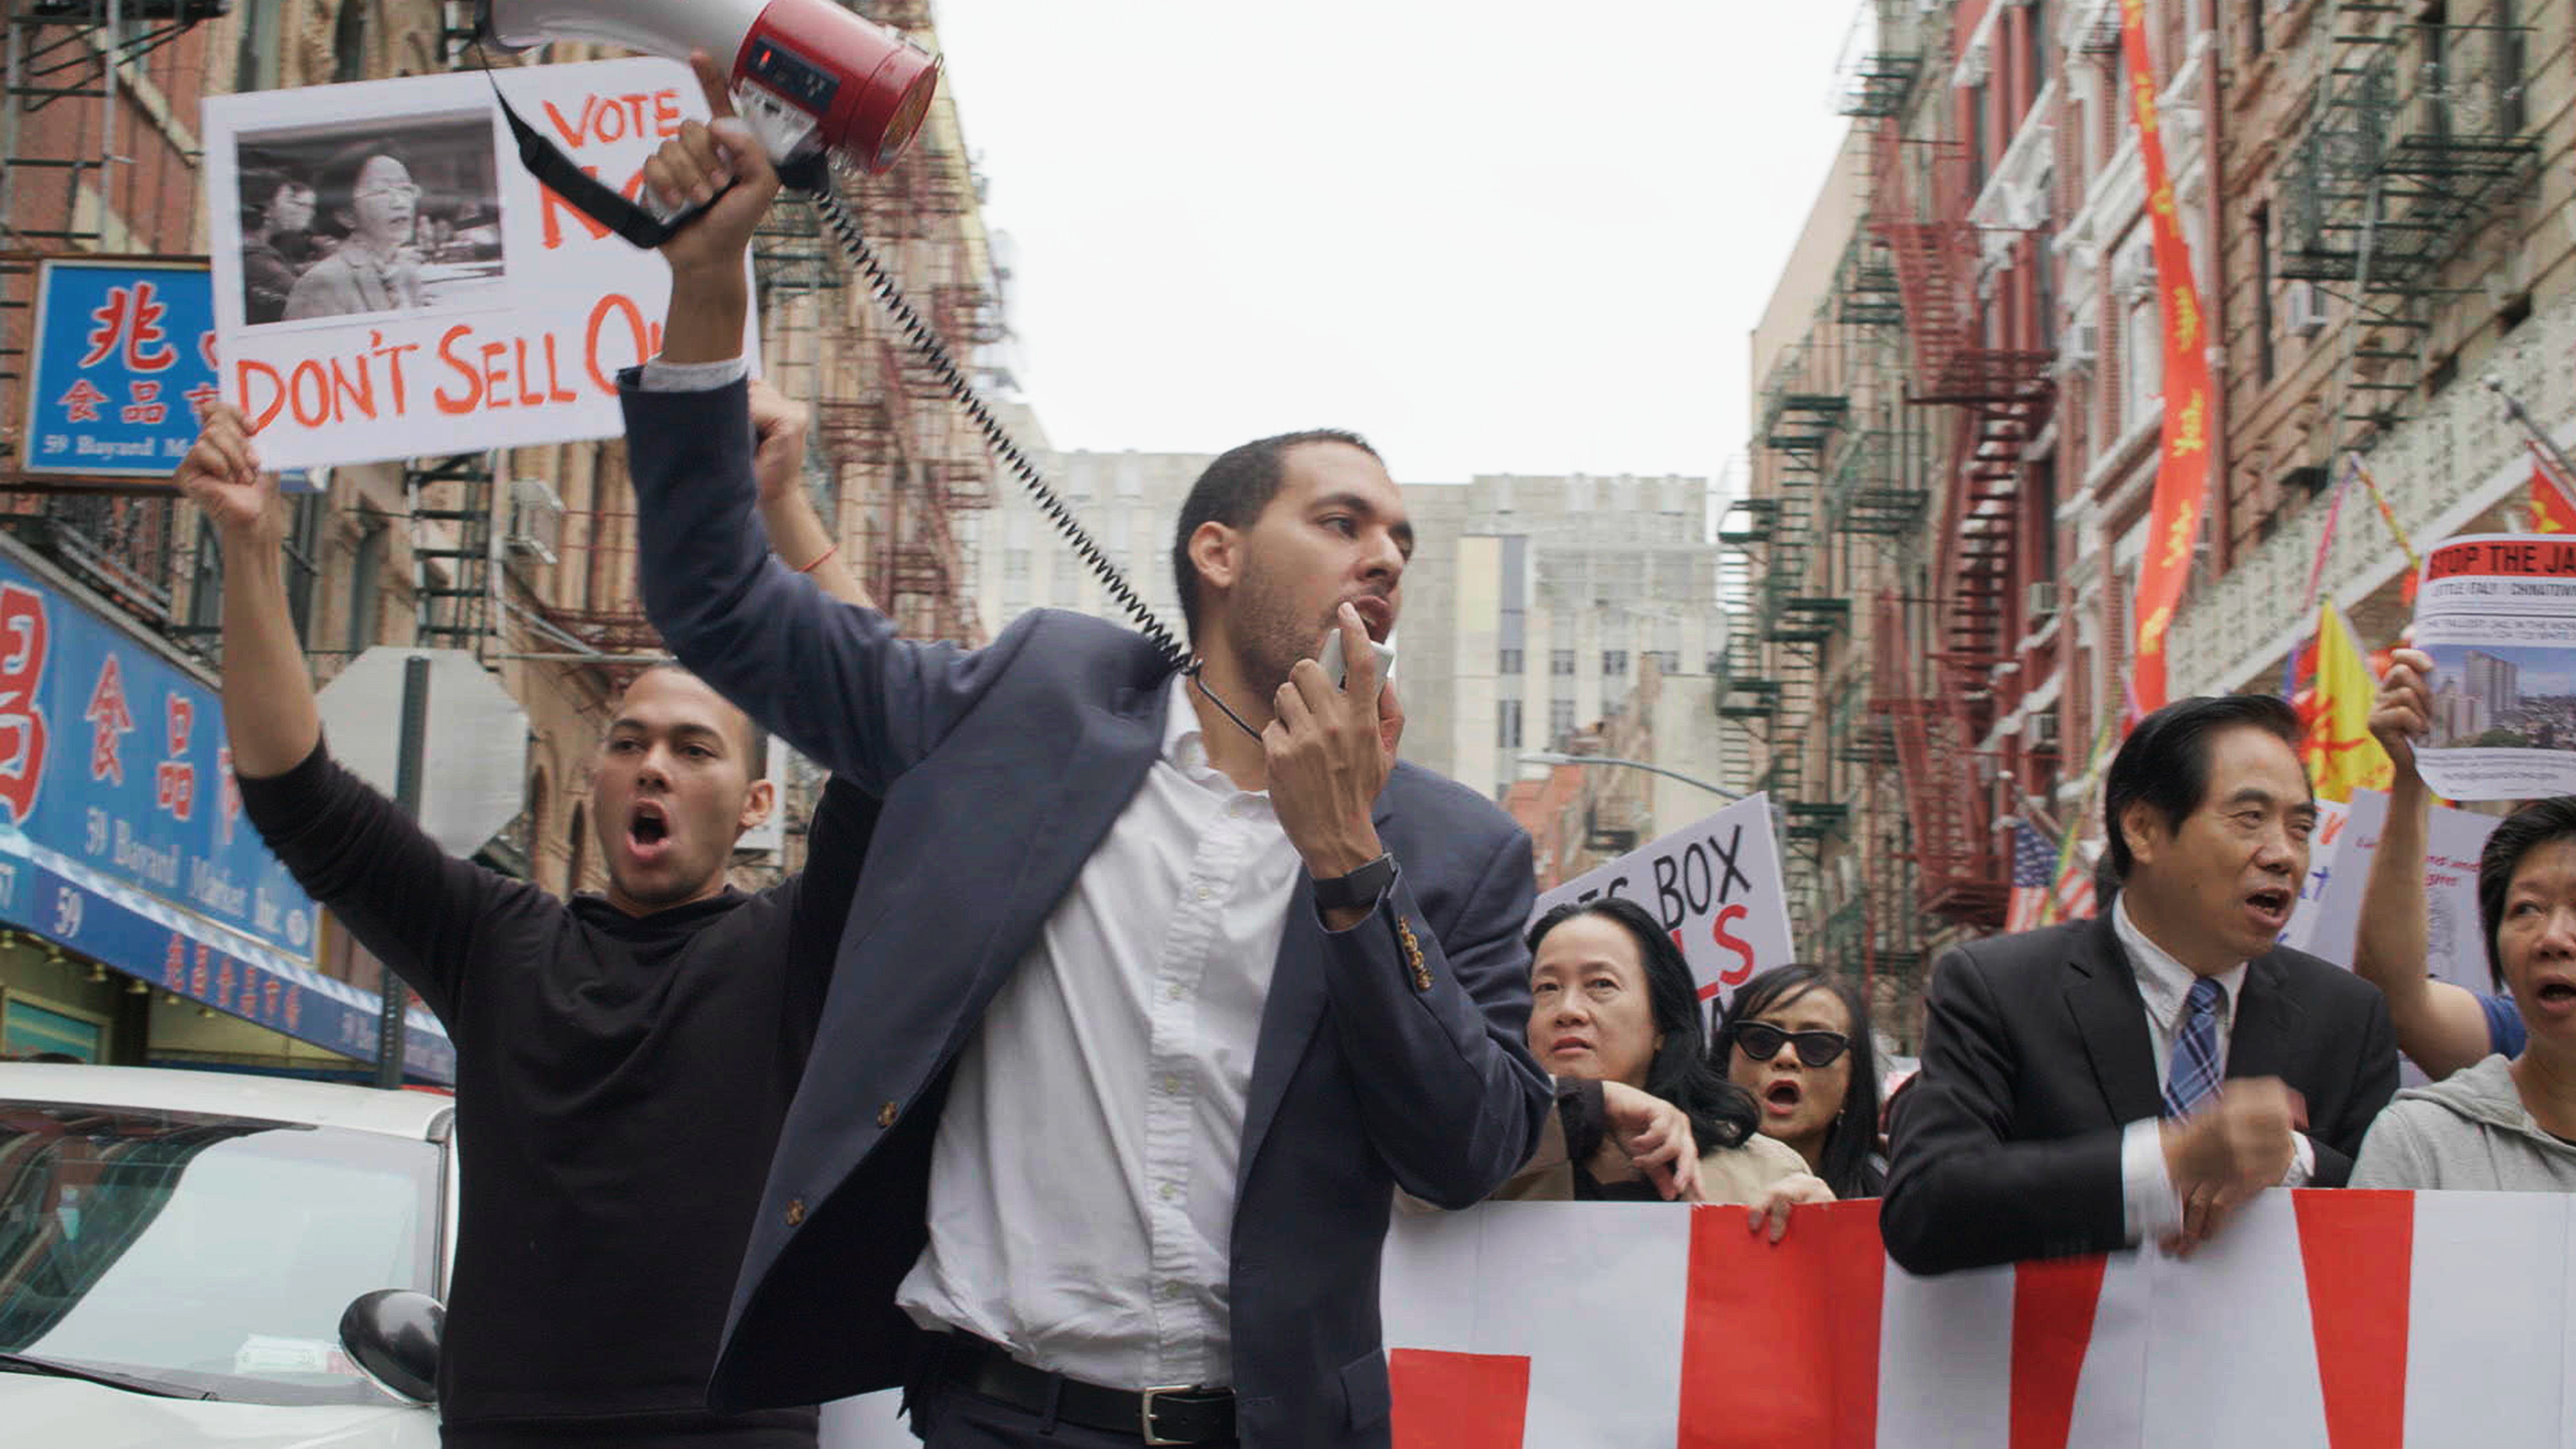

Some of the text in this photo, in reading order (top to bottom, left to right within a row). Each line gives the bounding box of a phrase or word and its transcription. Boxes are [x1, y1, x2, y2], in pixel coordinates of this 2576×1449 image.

[542, 88, 681, 148] VOTE
[77, 280, 217, 373] 兆
[237, 330, 421, 437] DON'T
[434, 323, 577, 415] SELL
[2428, 546, 2479, 581] STOP
[2488, 545, 2536, 573] THE
[54, 886, 83, 938] 59
[1654, 824, 1752, 932] BOX
